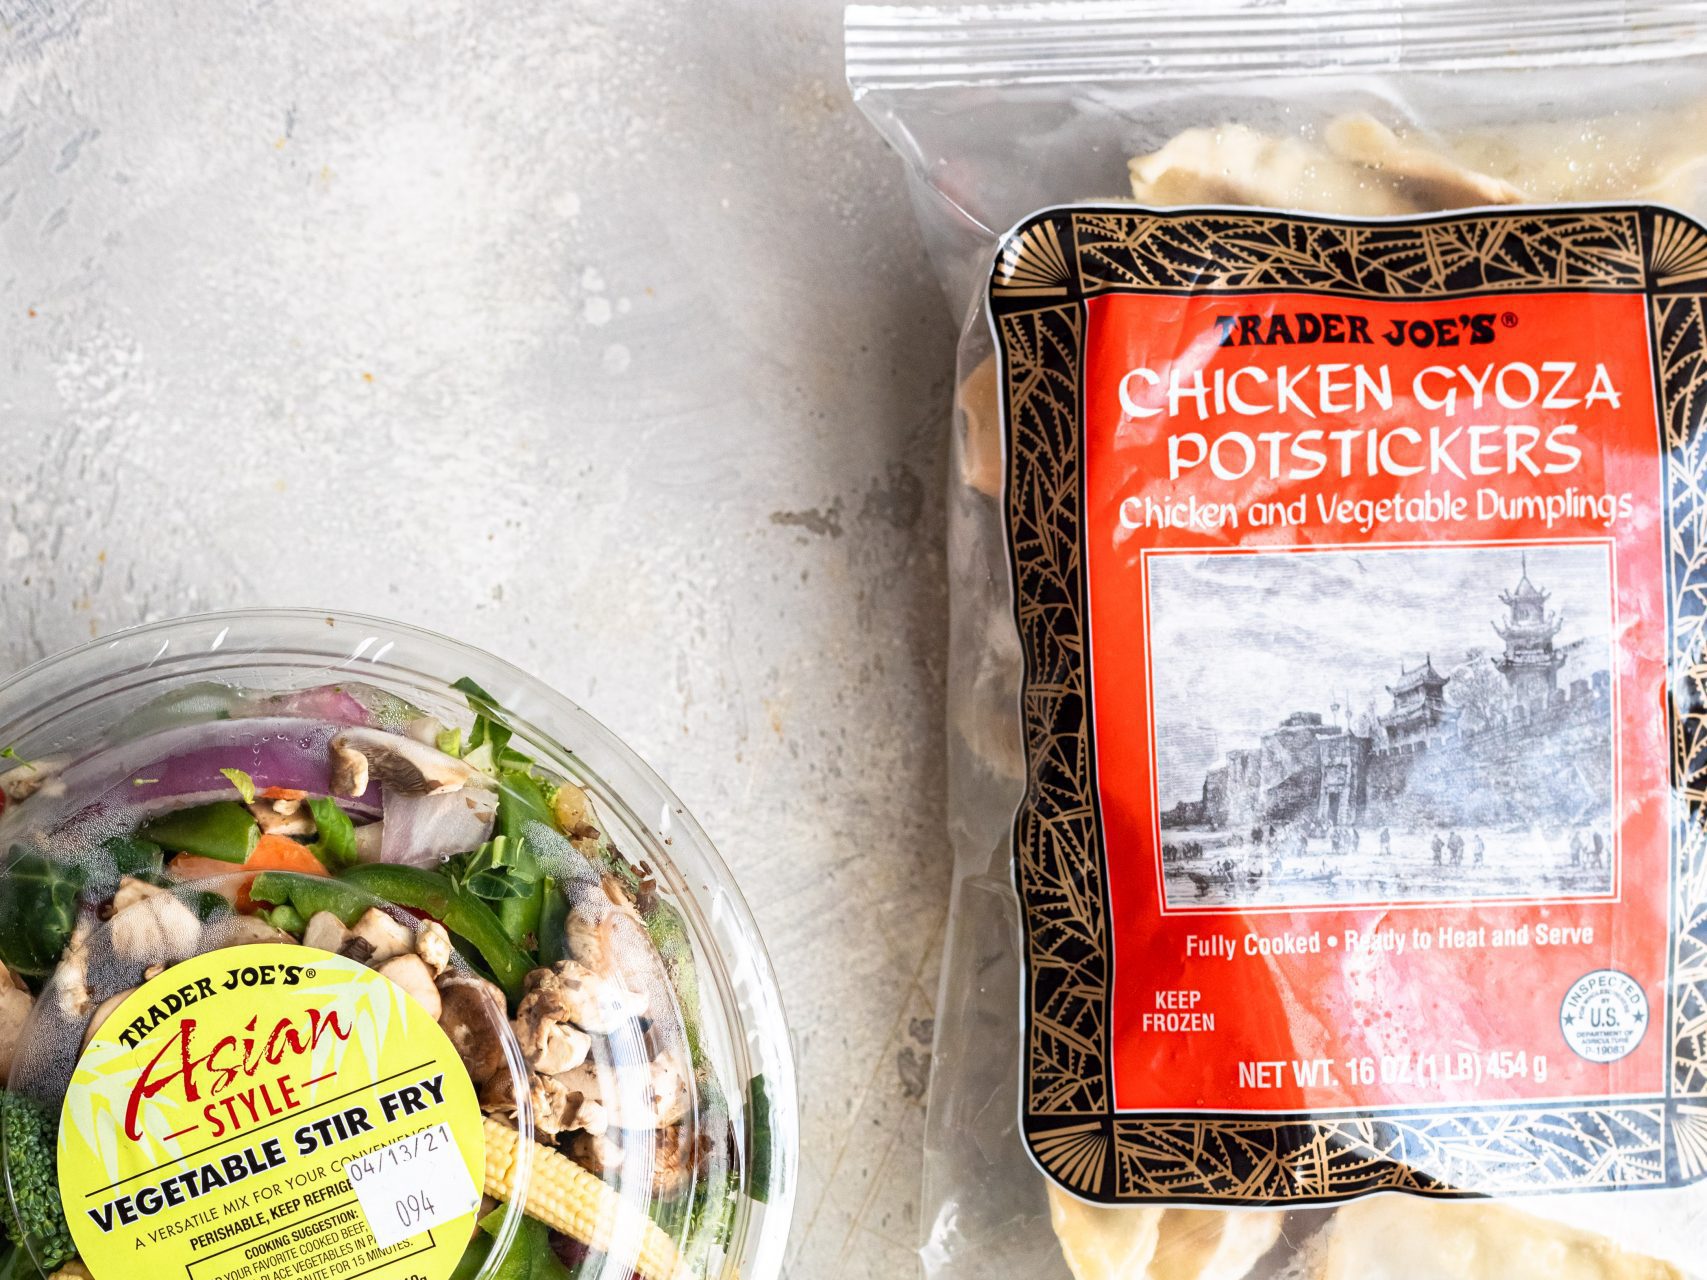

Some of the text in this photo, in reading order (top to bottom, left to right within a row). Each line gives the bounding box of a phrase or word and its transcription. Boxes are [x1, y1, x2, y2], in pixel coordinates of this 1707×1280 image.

[1214, 315, 1374, 347] TRADER
[1118, 361, 1622, 421] CHICKEN GYOZA
[1168, 425, 1583, 481] POTSTICKERS
[1120, 488, 1633, 533] Chicken and Vegetable Dumplings
[1186, 934, 1236, 961] Fully
[1244, 931, 1320, 956] Cooked
[1412, 928, 1432, 949] to
[1439, 927, 1485, 949] Heat
[1492, 924, 1529, 947] and
[1535, 925, 1594, 946] Serve
[118, 977, 217, 1050] TRADER
[1155, 991, 1201, 1010] KEEP
[1568, 976, 1640, 1008] INSPECTED
[1142, 1012, 1215, 1033] FROZEN
[1591, 1007, 1620, 1027] U.S.
[124, 1008, 353, 1142] Asian
[1239, 1051, 1547, 1088] NET WT. 16 OZ (1 LB) 454 g
[203, 1072, 301, 1138] STYLE
[87, 1137, 286, 1234] VEGETABLE
[294, 1106, 374, 1156] STIR
[382, 1074, 445, 1123] FRY
[350, 1125, 449, 1182] 04/13/21
[135, 1166, 327, 1250] A VERSATILE MIX FOR YOUR
[190, 1178, 354, 1250] PERISHABLE, KEEP REFRIGE
[396, 1189, 434, 1227] 094
[244, 1234, 291, 1260] COOKING
[292, 1209, 359, 1242] SUGGESTION:
[253, 1250, 298, 1273] FAVORITE
[300, 1232, 339, 1256] COOKED
[341, 1221, 369, 1239] BEEF,
[291, 1243, 354, 1275] VEGETABLES
[355, 1237, 366, 1250] IN
[329, 1260, 351, 1276] FOR
[351, 1254, 365, 1267] 15
